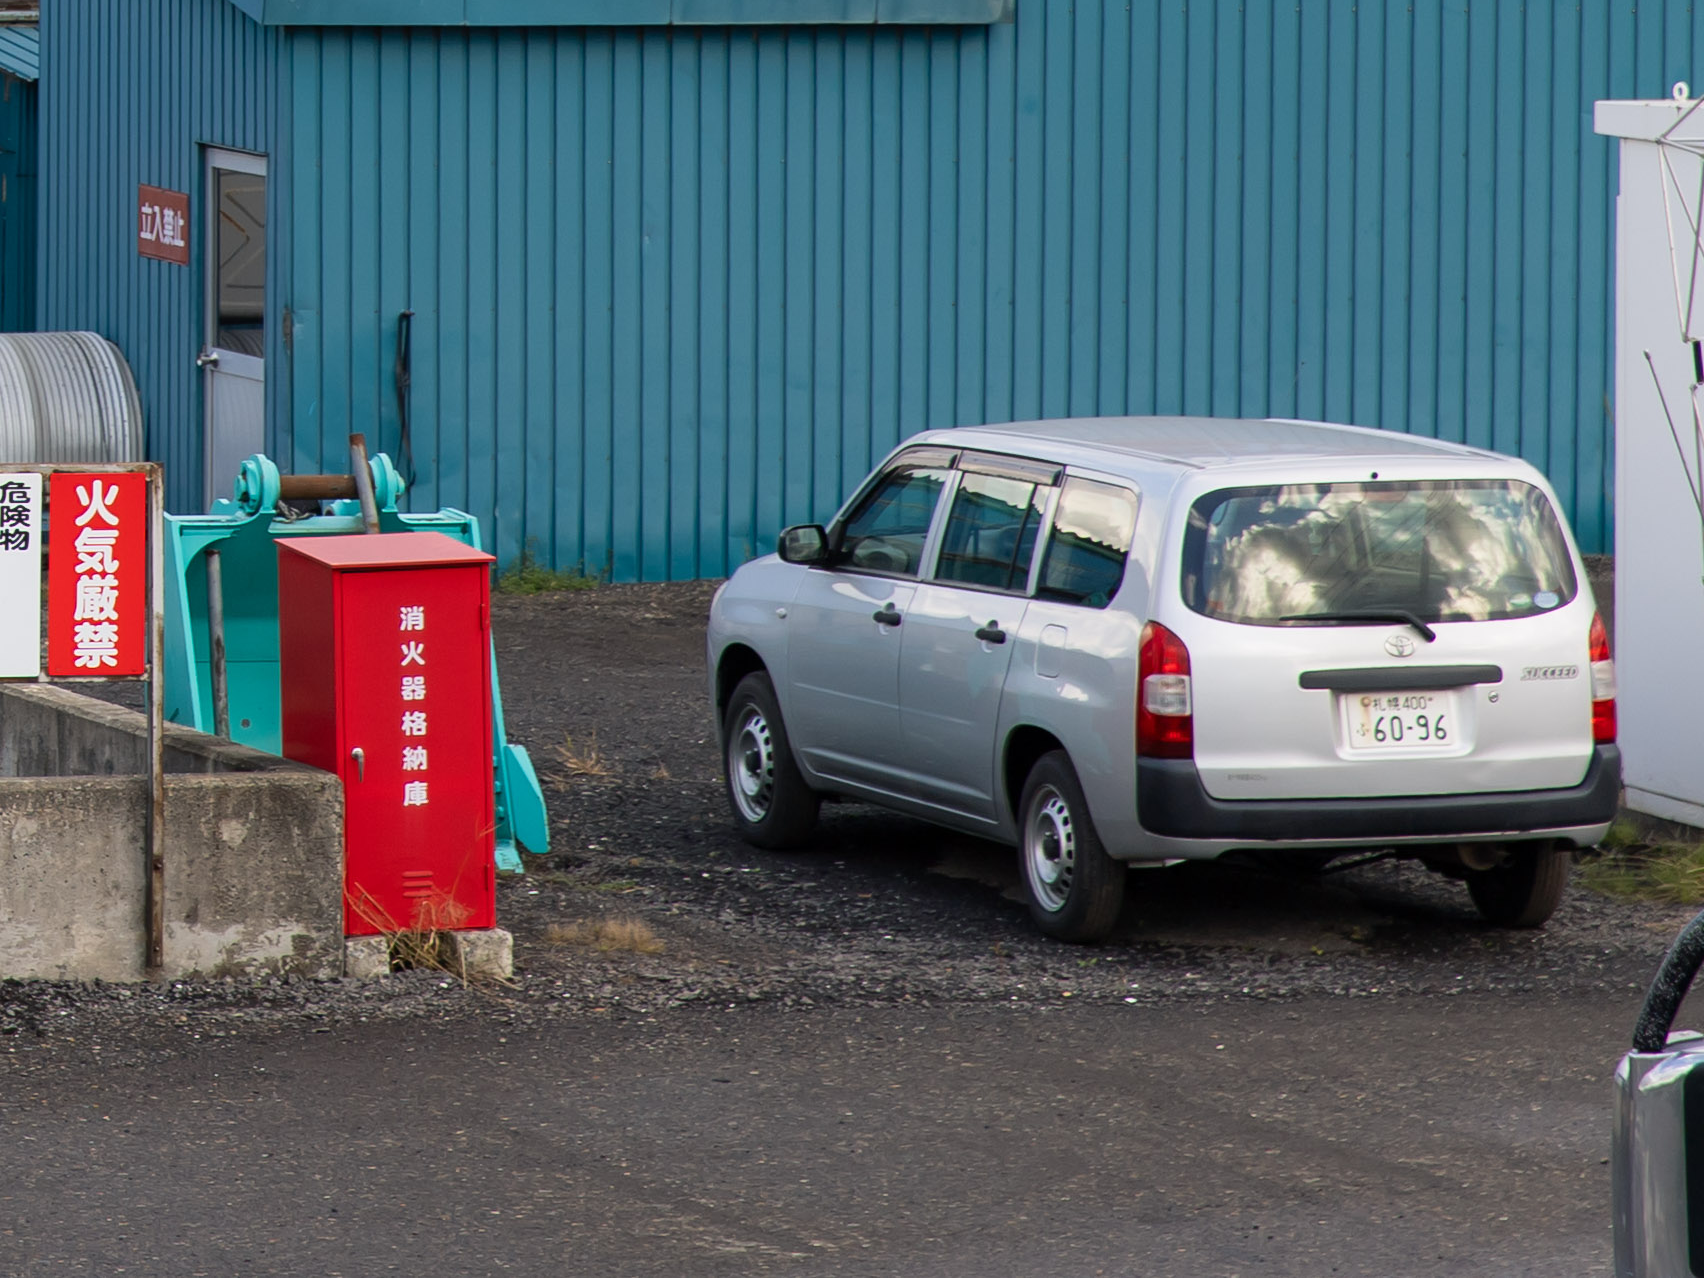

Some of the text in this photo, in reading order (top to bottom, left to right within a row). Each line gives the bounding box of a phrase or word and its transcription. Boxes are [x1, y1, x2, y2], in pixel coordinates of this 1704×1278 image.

[139, 201, 186, 248] 立入禁止
[0, 480, 31, 552] 危険物
[74, 479, 120, 669] 火気厳禁
[1519, 664, 1579, 681] SUCCEED
[398, 605, 430, 808] 消火器格納庫
[1373, 714, 1448, 742] 60-96
